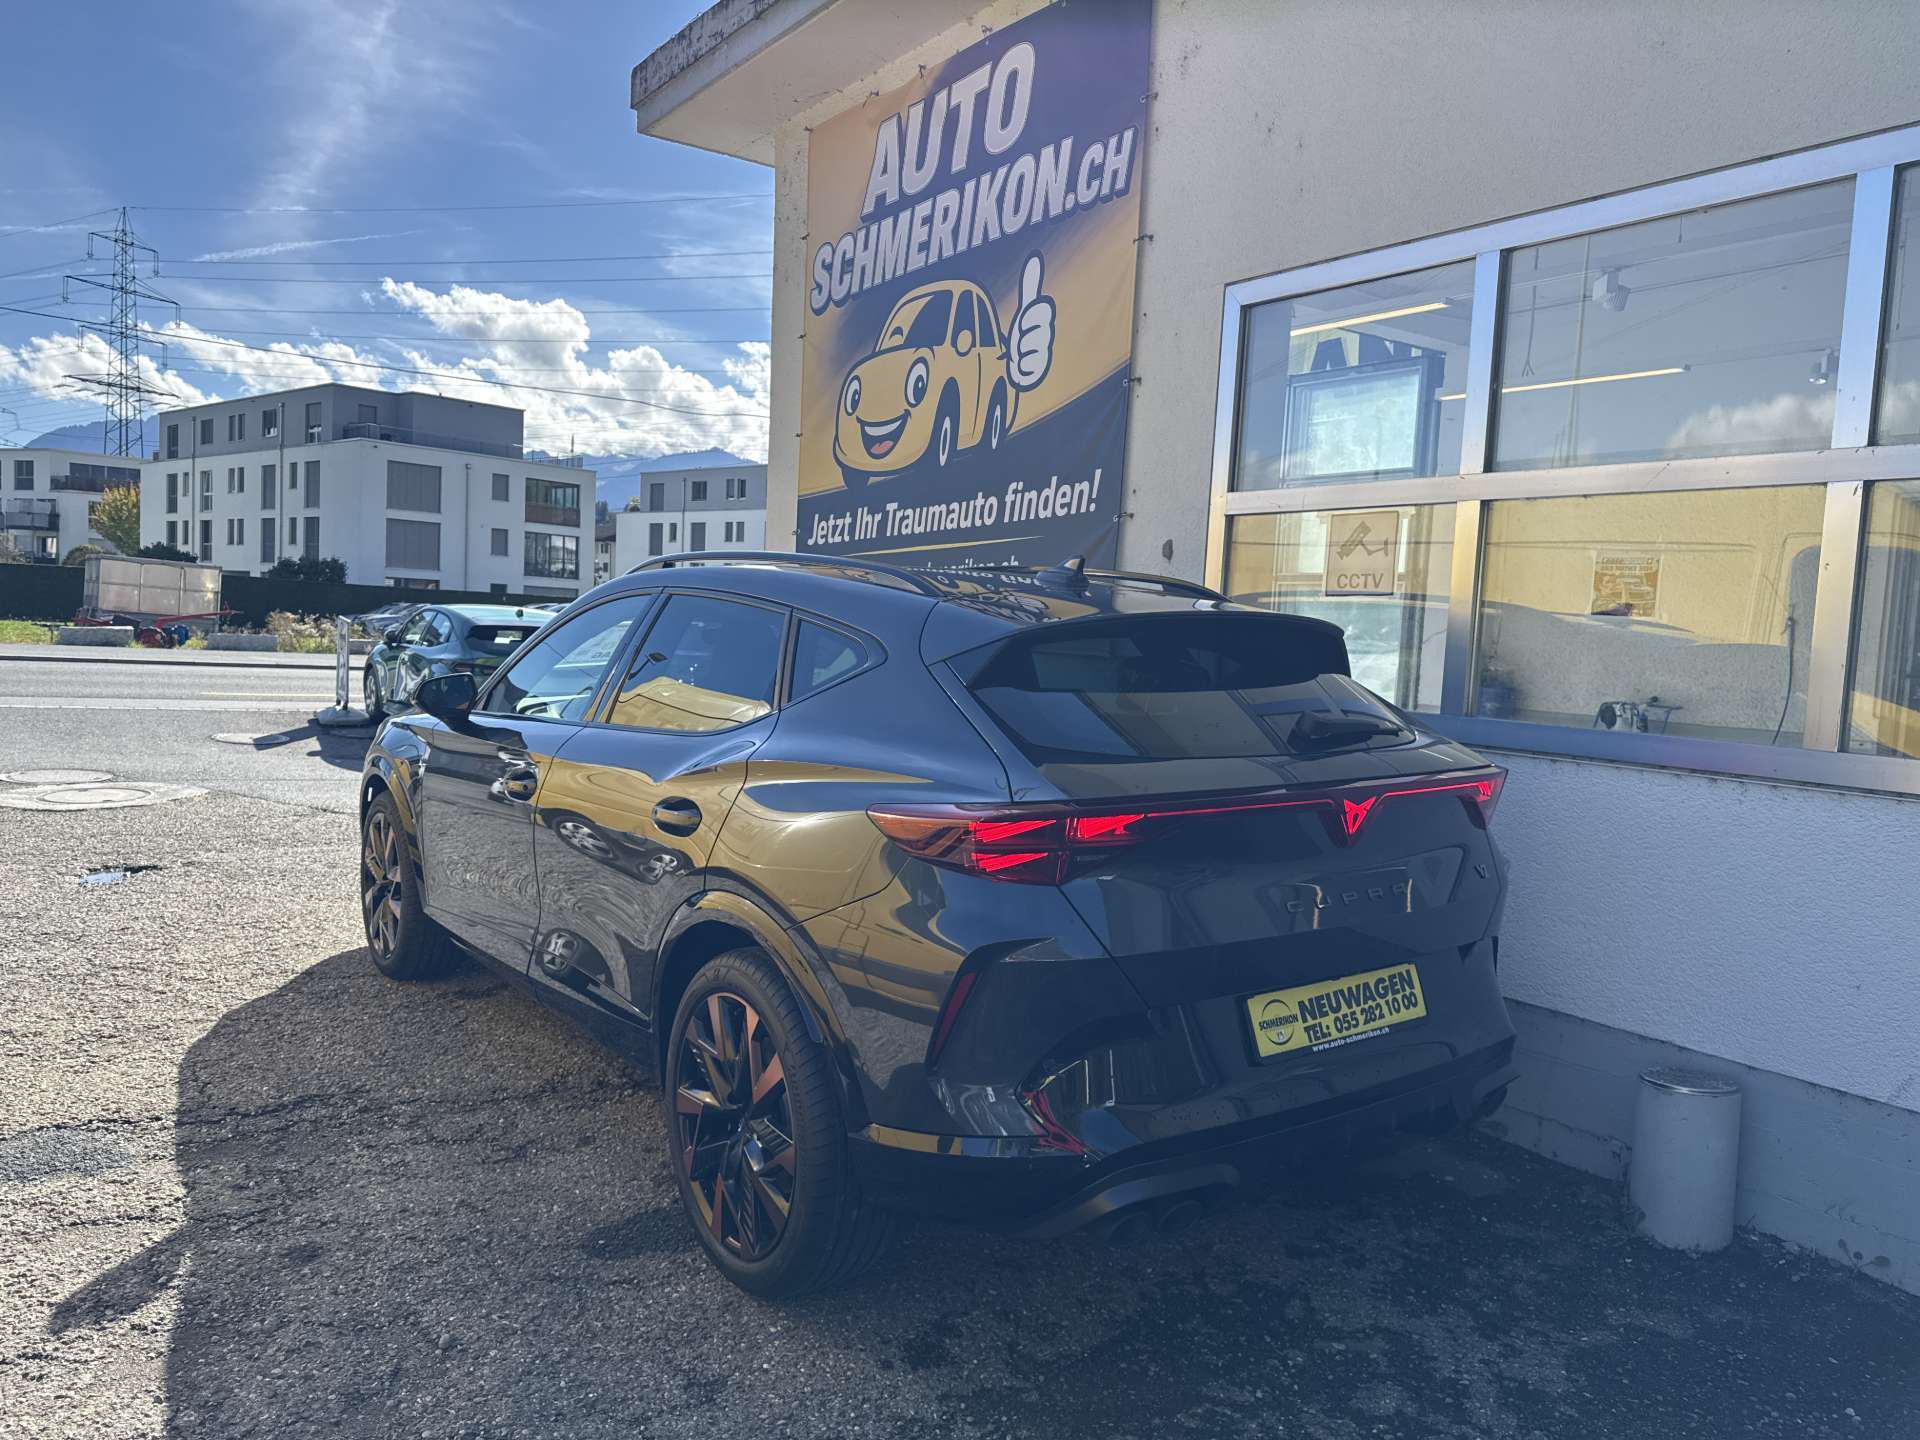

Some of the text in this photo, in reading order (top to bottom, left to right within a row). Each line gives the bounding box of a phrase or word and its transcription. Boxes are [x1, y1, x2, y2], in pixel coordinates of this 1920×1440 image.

[861, 41, 1036, 217] AUTO
[811, 127, 1136, 310] SCHMERIKON.CH
[808, 468, 1102, 546] Jetzt Ihr Traumauto finden!
[1336, 572, 1384, 589] CCTV
[1259, 1012, 1299, 1031] SCHMERIKON
[1298, 969, 1416, 1023] NEUWAGEN
[1304, 991, 1418, 1044] TEL: 055 282 10 00
